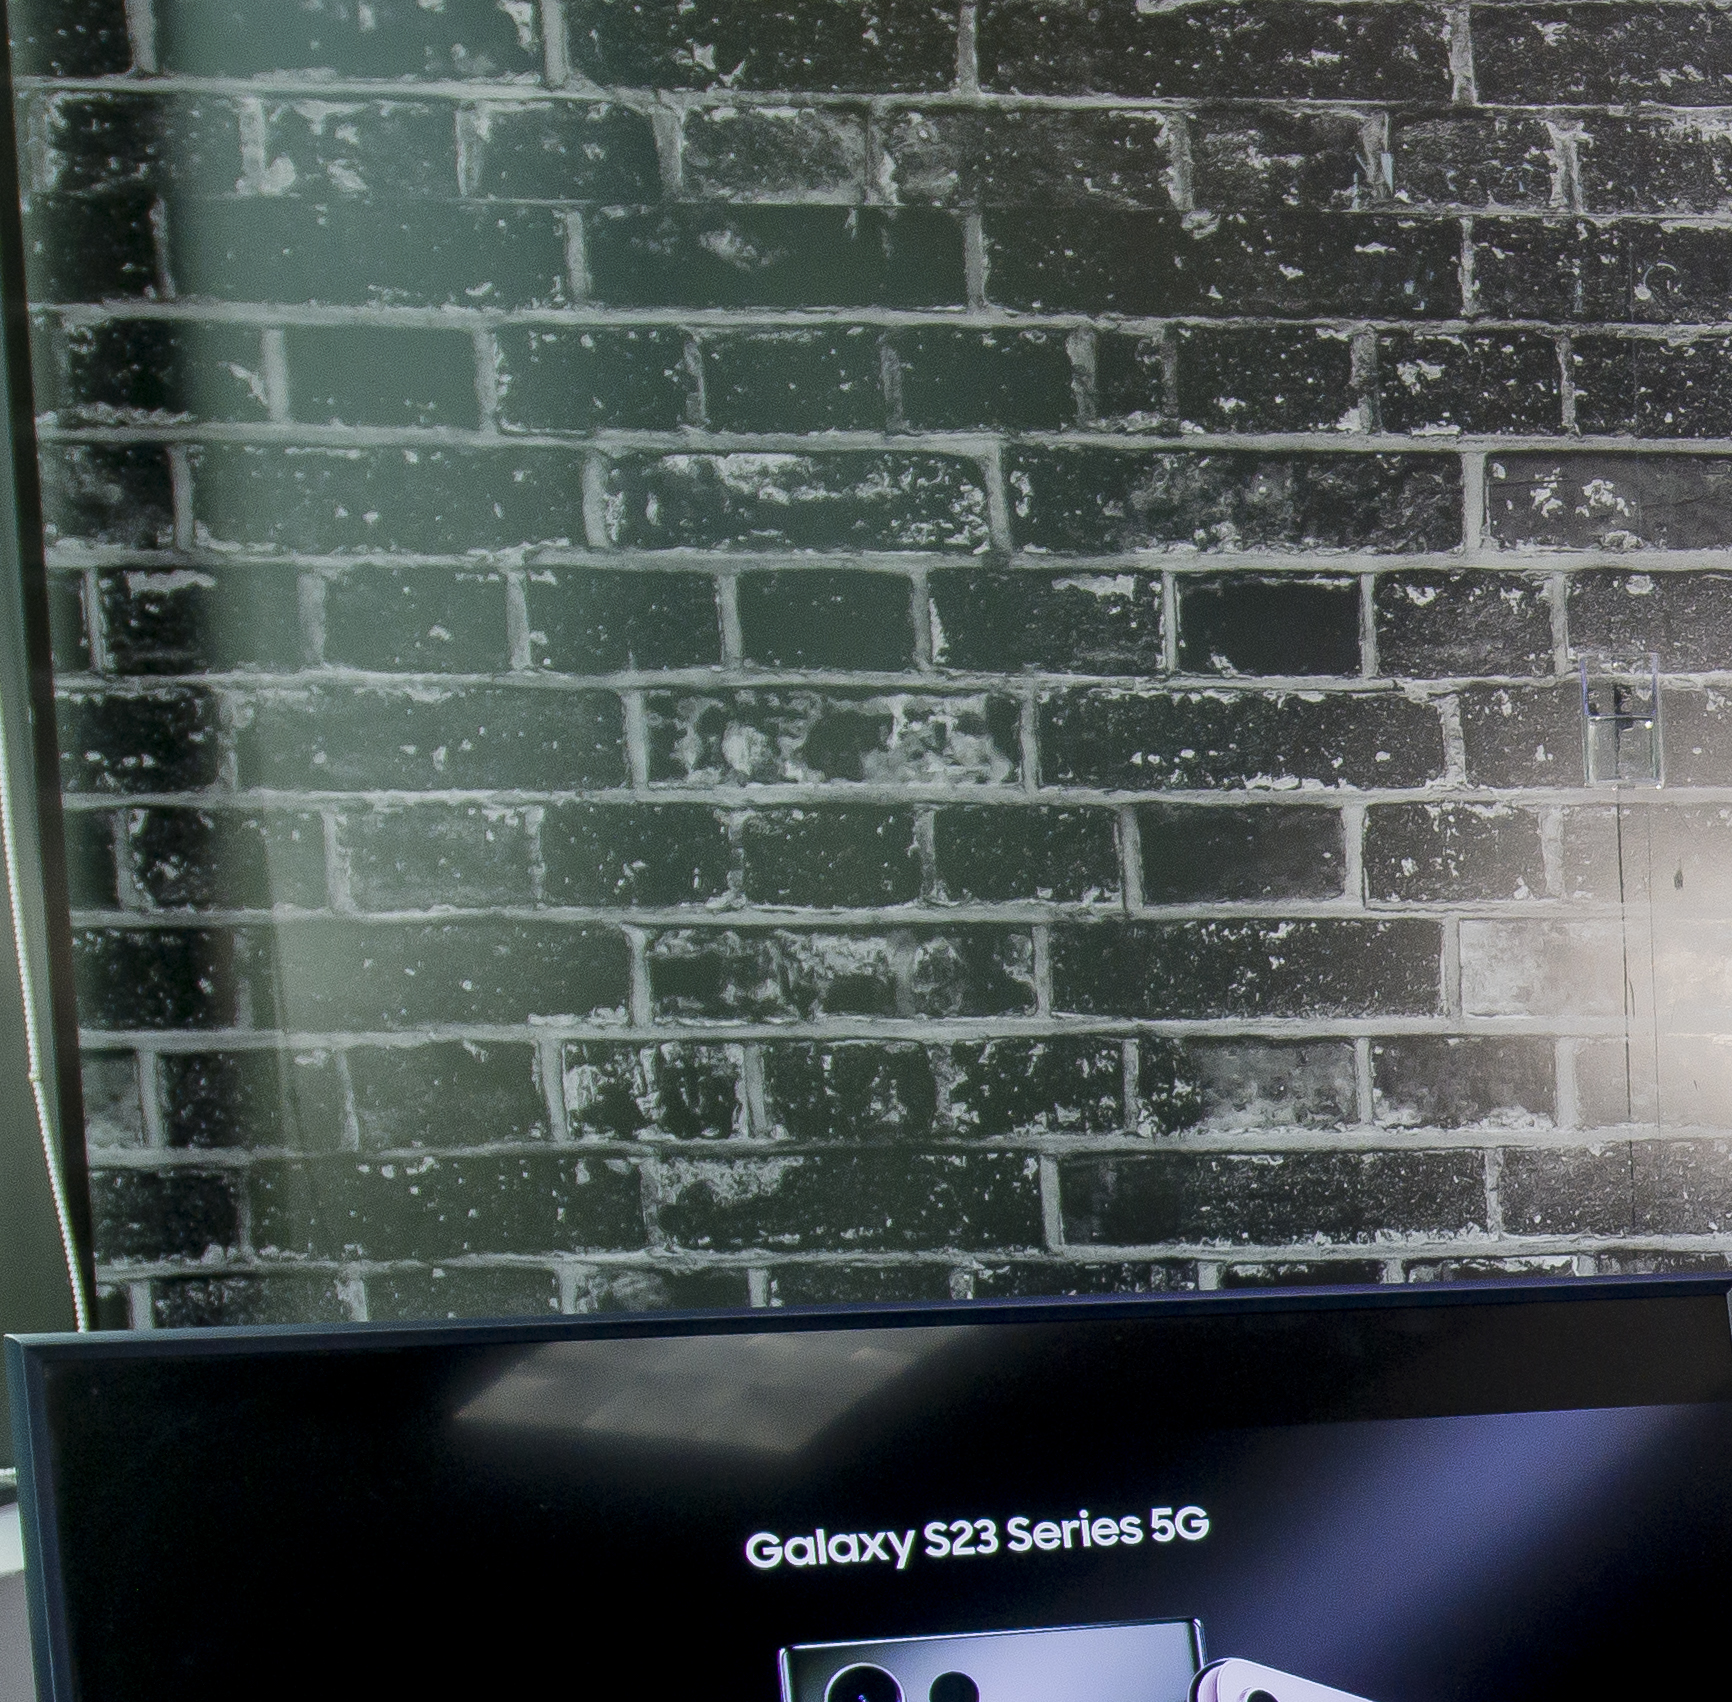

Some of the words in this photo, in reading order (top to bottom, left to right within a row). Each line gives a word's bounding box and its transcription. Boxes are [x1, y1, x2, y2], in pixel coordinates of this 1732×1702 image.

[744, 1528, 916, 1570] Galaxy
[924, 1518, 999, 1558] S23
[1006, 1510, 1142, 1552] Series
[1150, 1505, 1210, 1543] 5G
